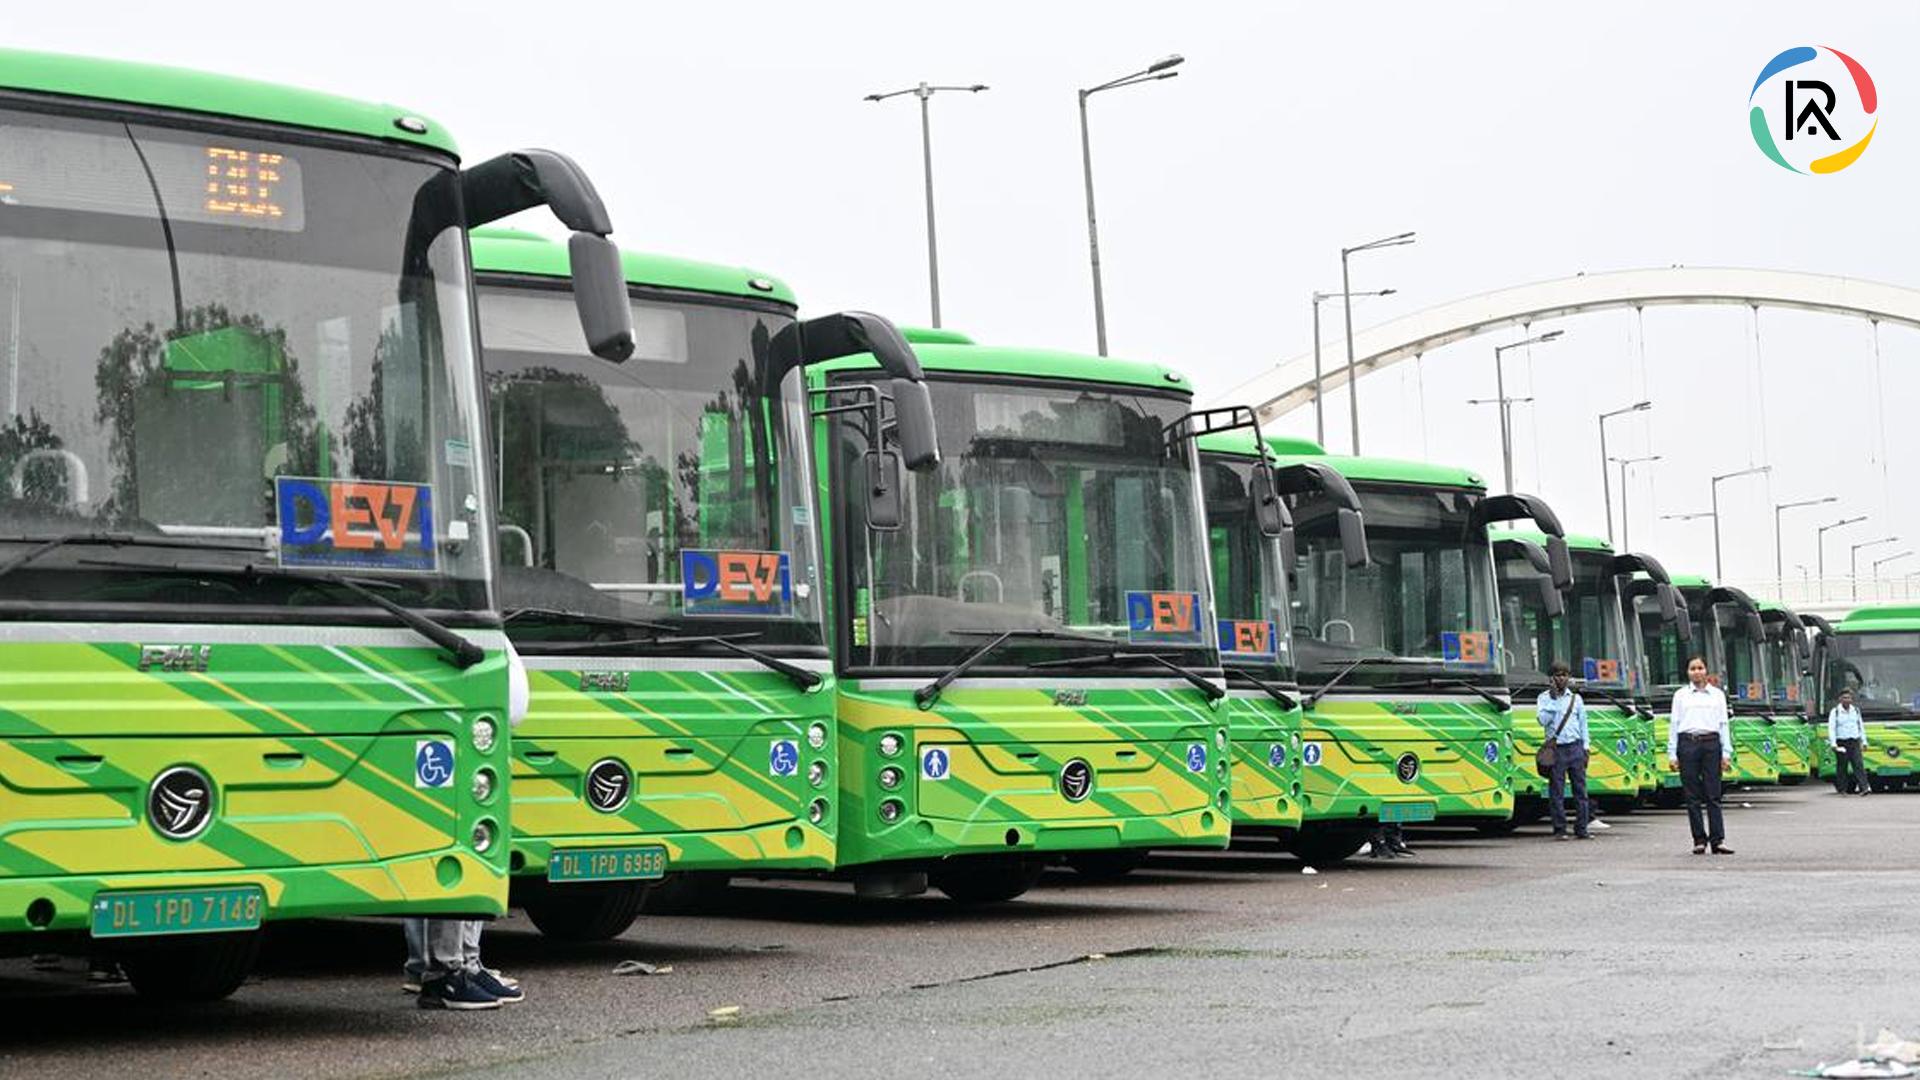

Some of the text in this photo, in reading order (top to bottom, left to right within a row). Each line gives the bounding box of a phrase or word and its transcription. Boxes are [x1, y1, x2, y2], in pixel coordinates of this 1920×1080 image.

[563, 852, 662, 876] DL 1PD 6958
[113, 895, 258, 929] DL 1PD 7148
